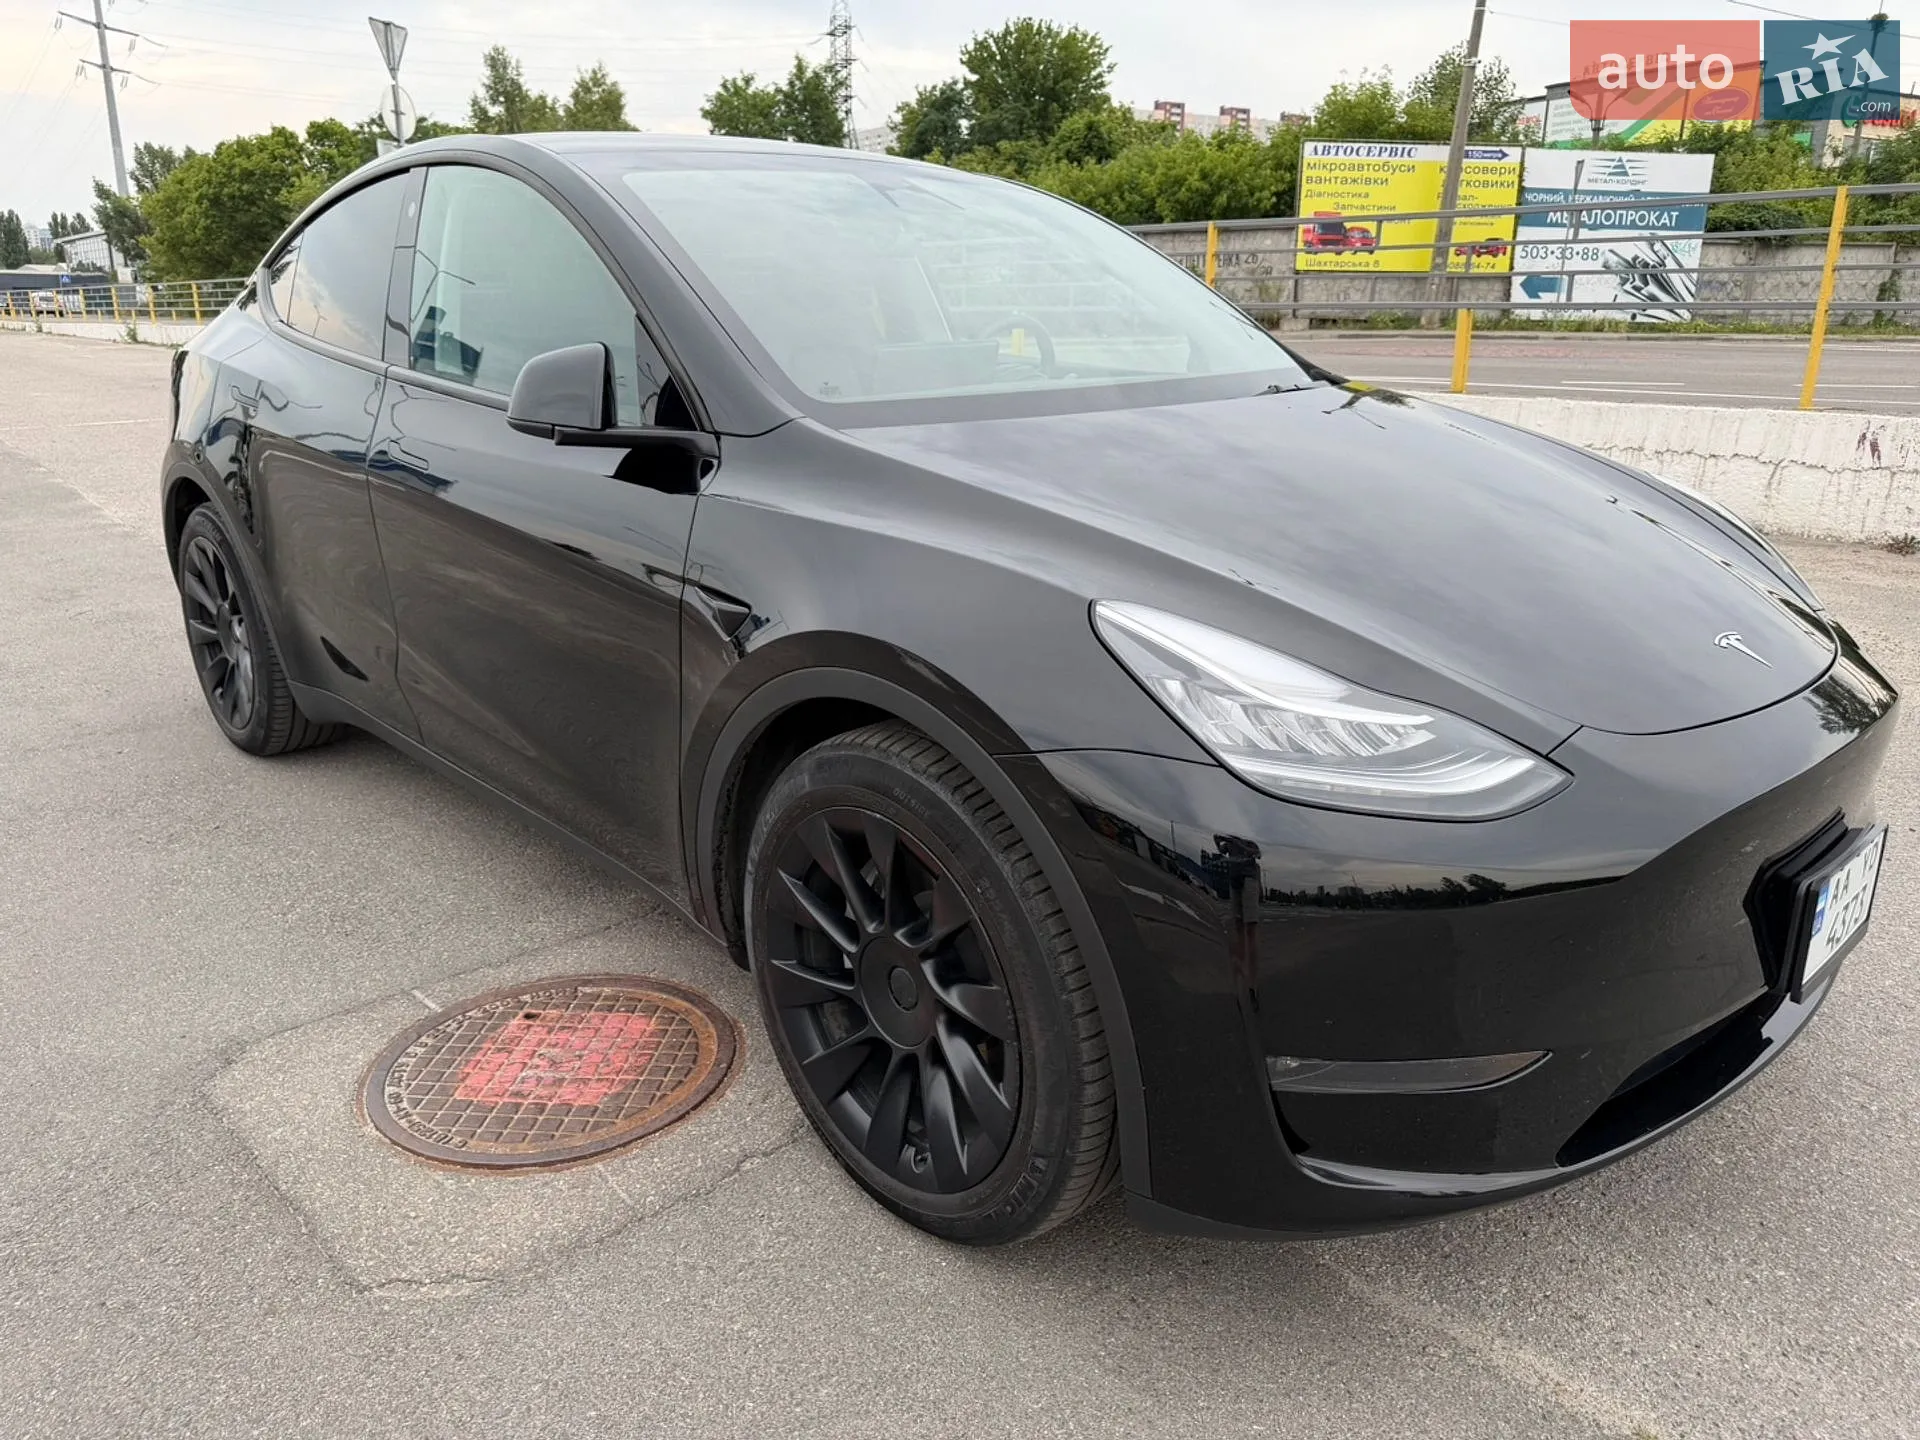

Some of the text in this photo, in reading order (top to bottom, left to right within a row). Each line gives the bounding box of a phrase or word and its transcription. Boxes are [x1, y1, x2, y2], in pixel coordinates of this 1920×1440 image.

[1309, 144, 1418, 158] АВТОСЕРВІС
[1305, 161, 1416, 176] мікроавтобуси
[1439, 164, 1516, 177] ксовери
[1305, 174, 1389, 186] вантажівки
[1304, 188, 1370, 199] Діагностика
[1333, 201, 1396, 212] Запчастини
[1305, 259, 1370, 269] Шахтарська
[1829, 867, 1851, 909] AA
